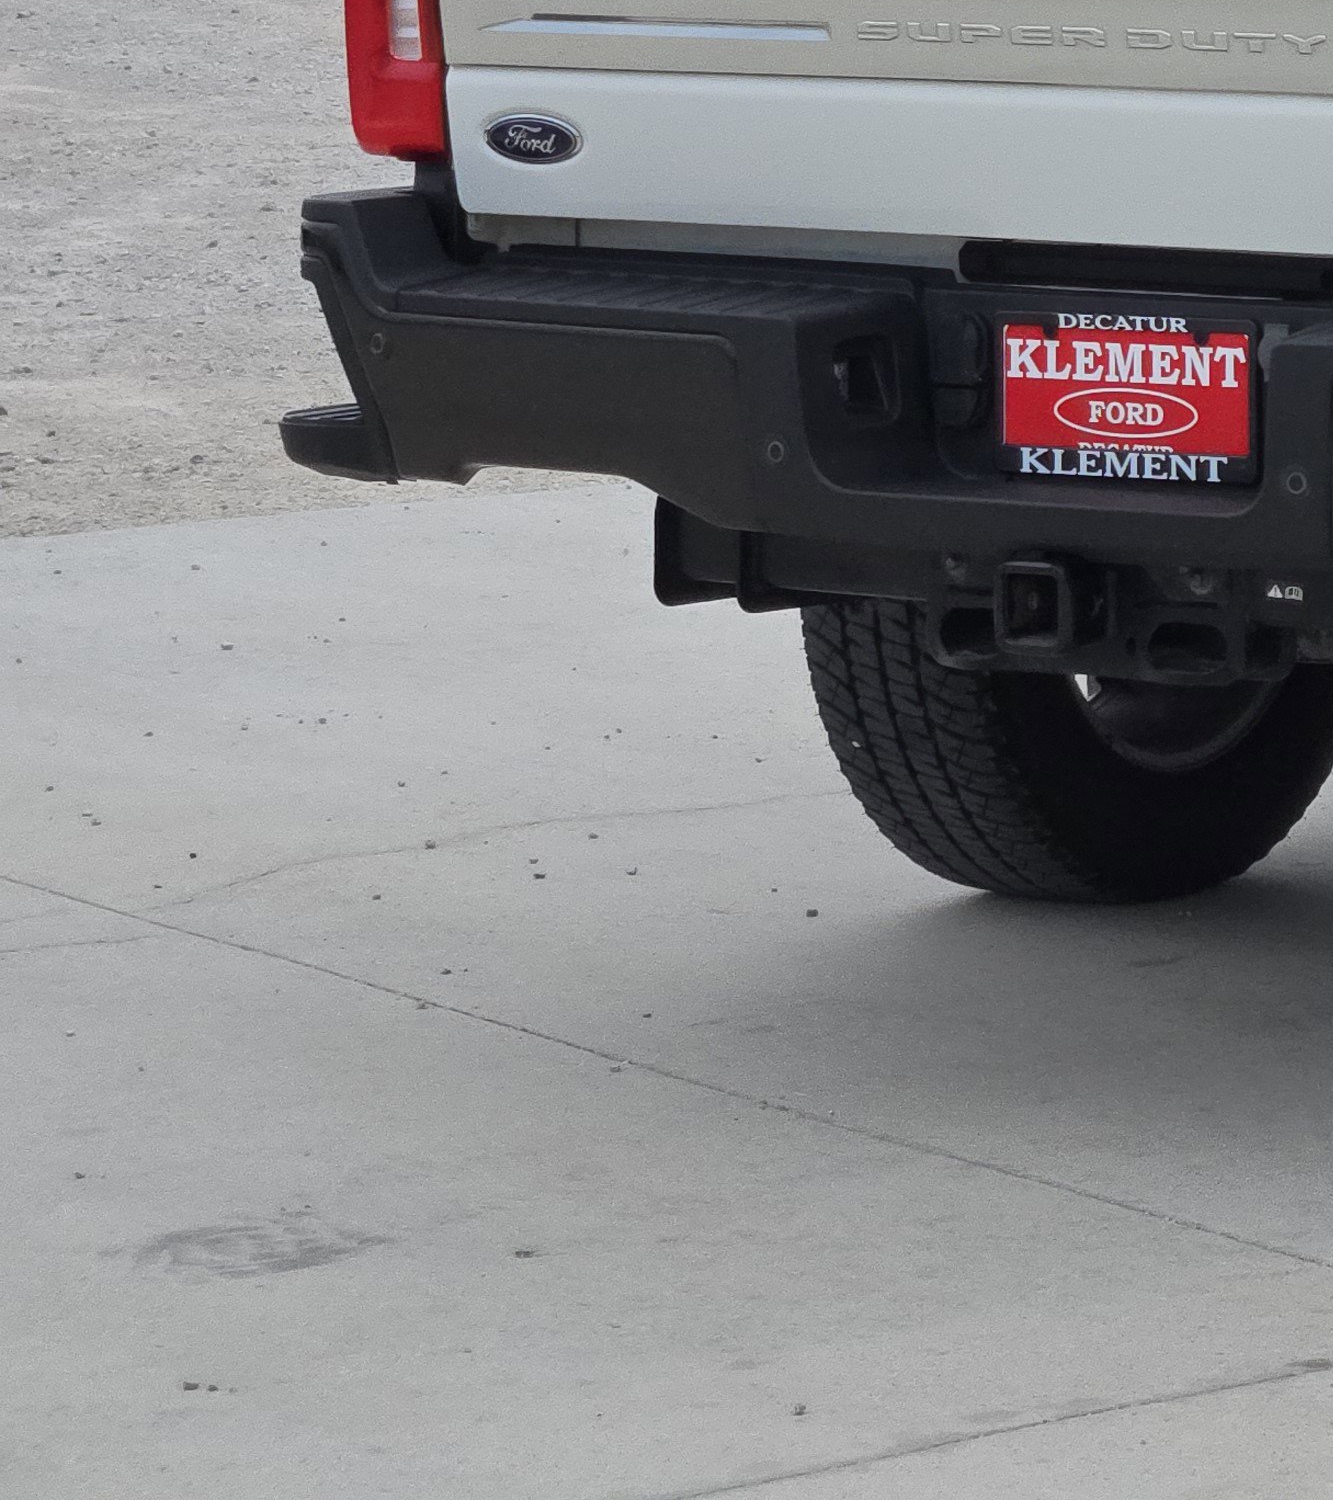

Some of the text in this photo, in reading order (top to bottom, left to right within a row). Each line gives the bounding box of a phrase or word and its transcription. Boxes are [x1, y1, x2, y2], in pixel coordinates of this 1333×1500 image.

[857, 20, 1327, 55] SUPER DUTY
[504, 124, 558, 155] Ford
[1057, 313, 1189, 333] DECATUR
[1006, 337, 1247, 388] KLEMENT
[1088, 400, 1165, 426] FORD
[1019, 447, 1228, 483] KLEMENT
